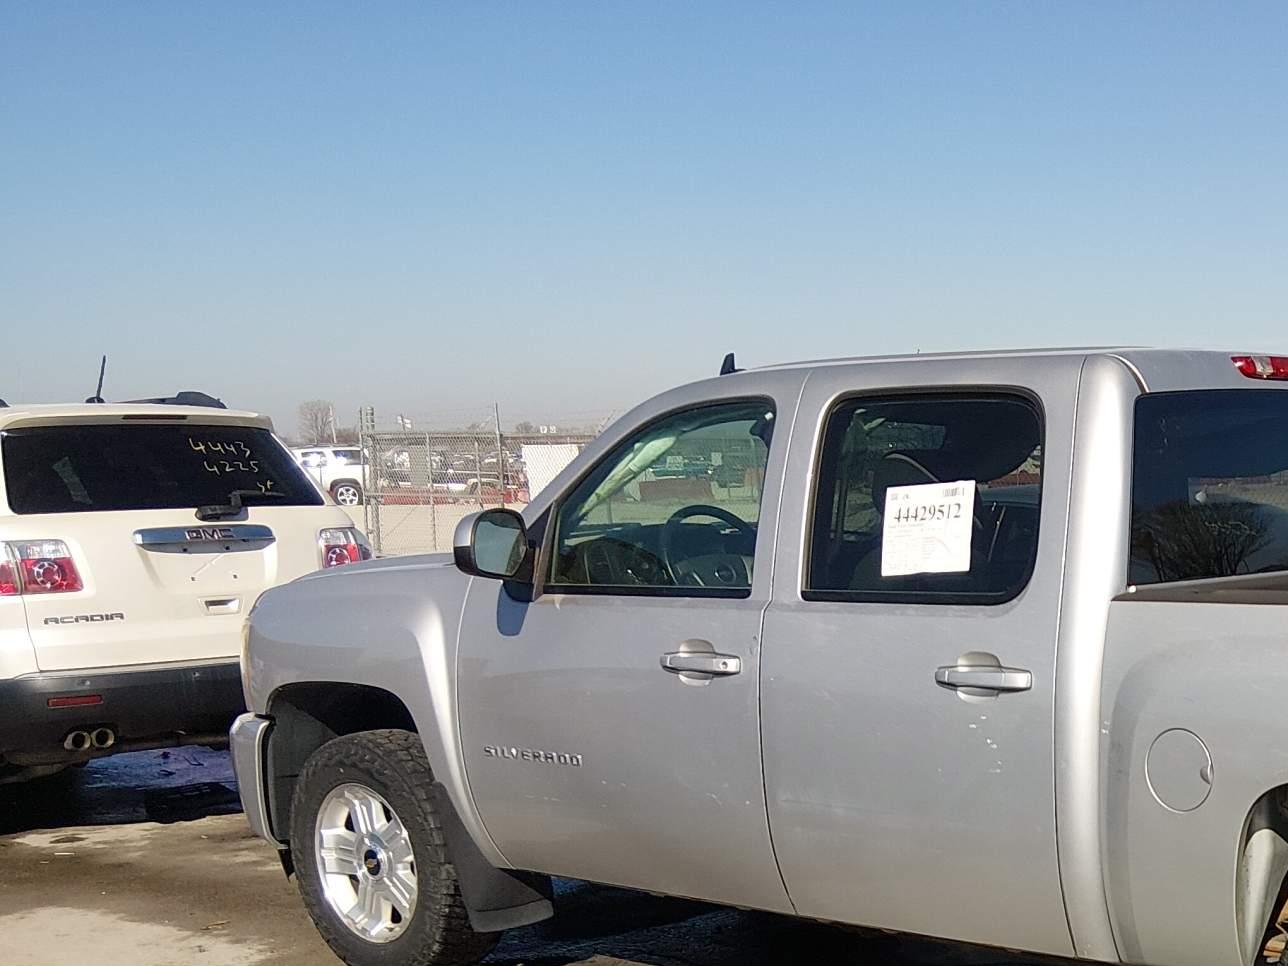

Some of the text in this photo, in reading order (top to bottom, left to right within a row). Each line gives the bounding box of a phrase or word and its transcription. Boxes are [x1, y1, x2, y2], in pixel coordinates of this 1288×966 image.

[188, 436, 251, 458] 4443
[203, 460, 260, 476] 4225
[893, 502, 962, 523] 44429512
[185, 528, 236, 541] GMC
[43, 612, 125, 625] ACADIA
[483, 744, 584, 767] SILVERADO
